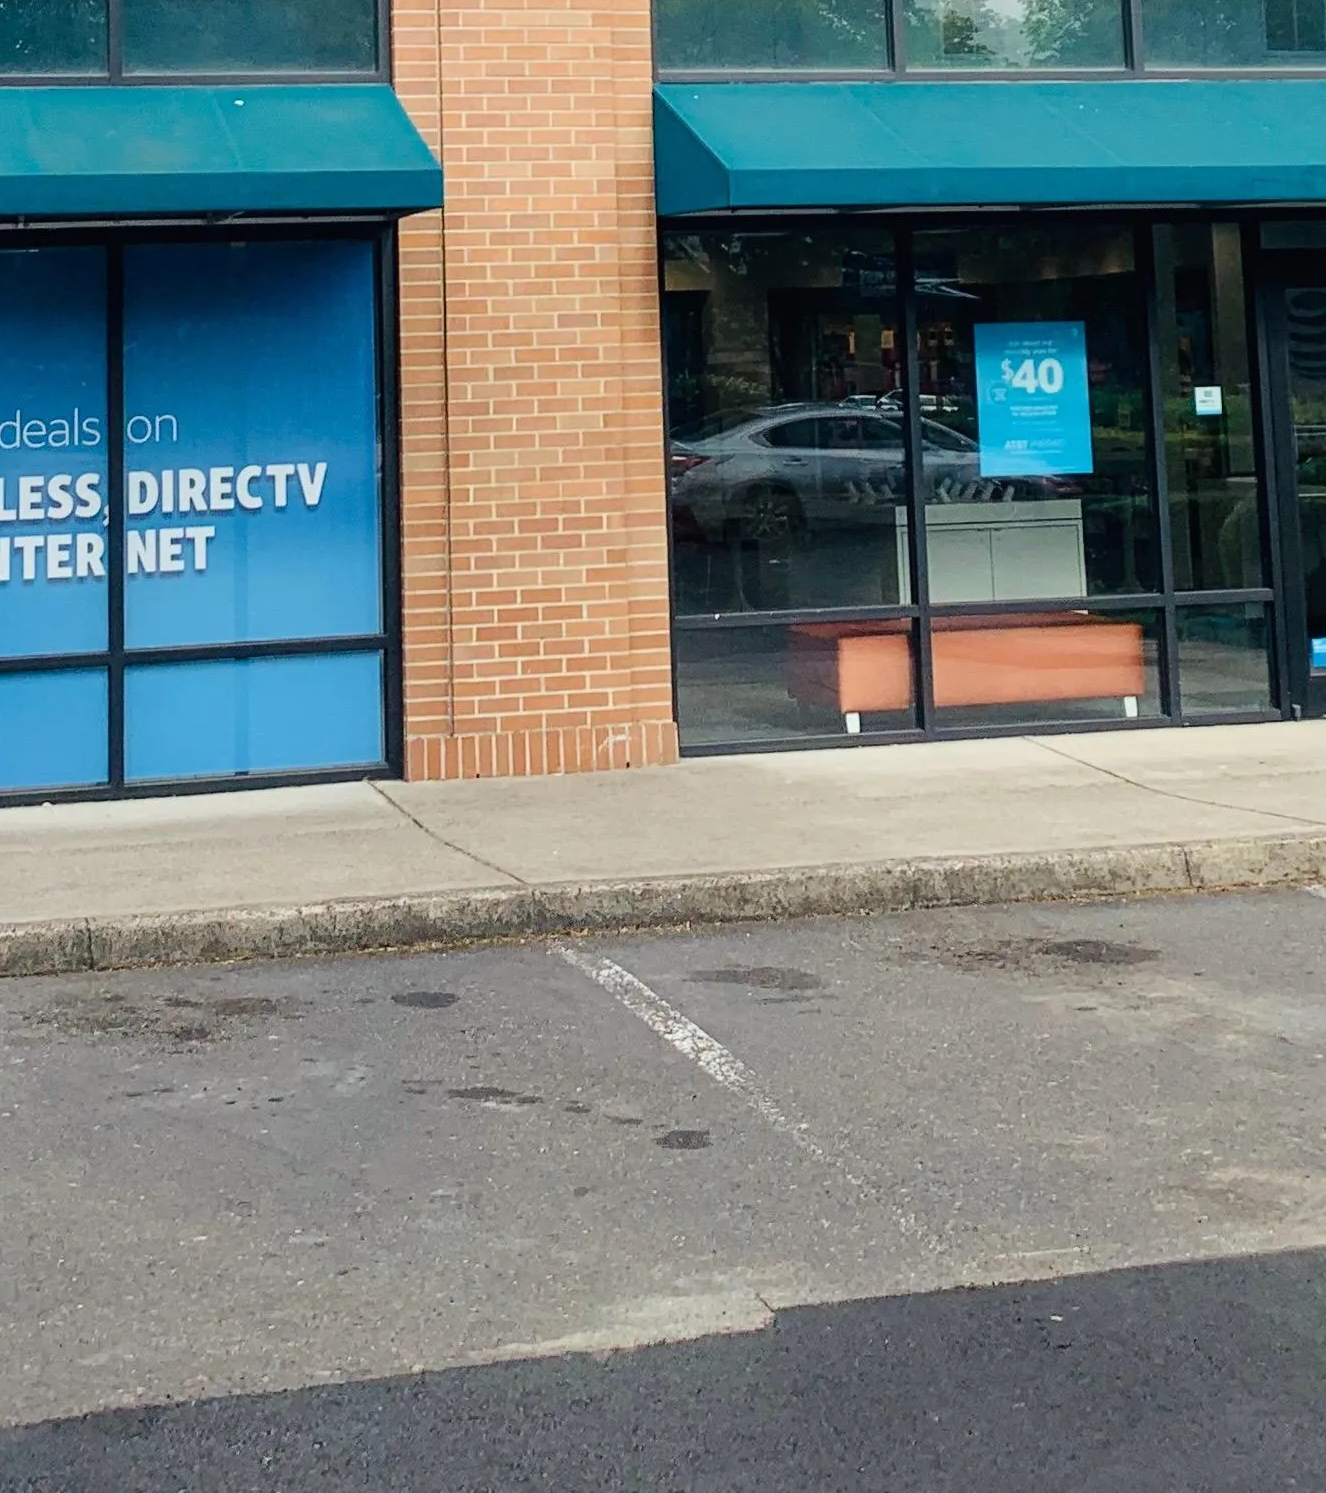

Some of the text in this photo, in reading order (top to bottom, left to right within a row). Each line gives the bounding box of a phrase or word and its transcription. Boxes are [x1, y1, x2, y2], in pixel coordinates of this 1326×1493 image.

[1001, 357, 1064, 394] $40
[126, 413, 177, 444] on
[127, 462, 327, 515] DIRECTV
